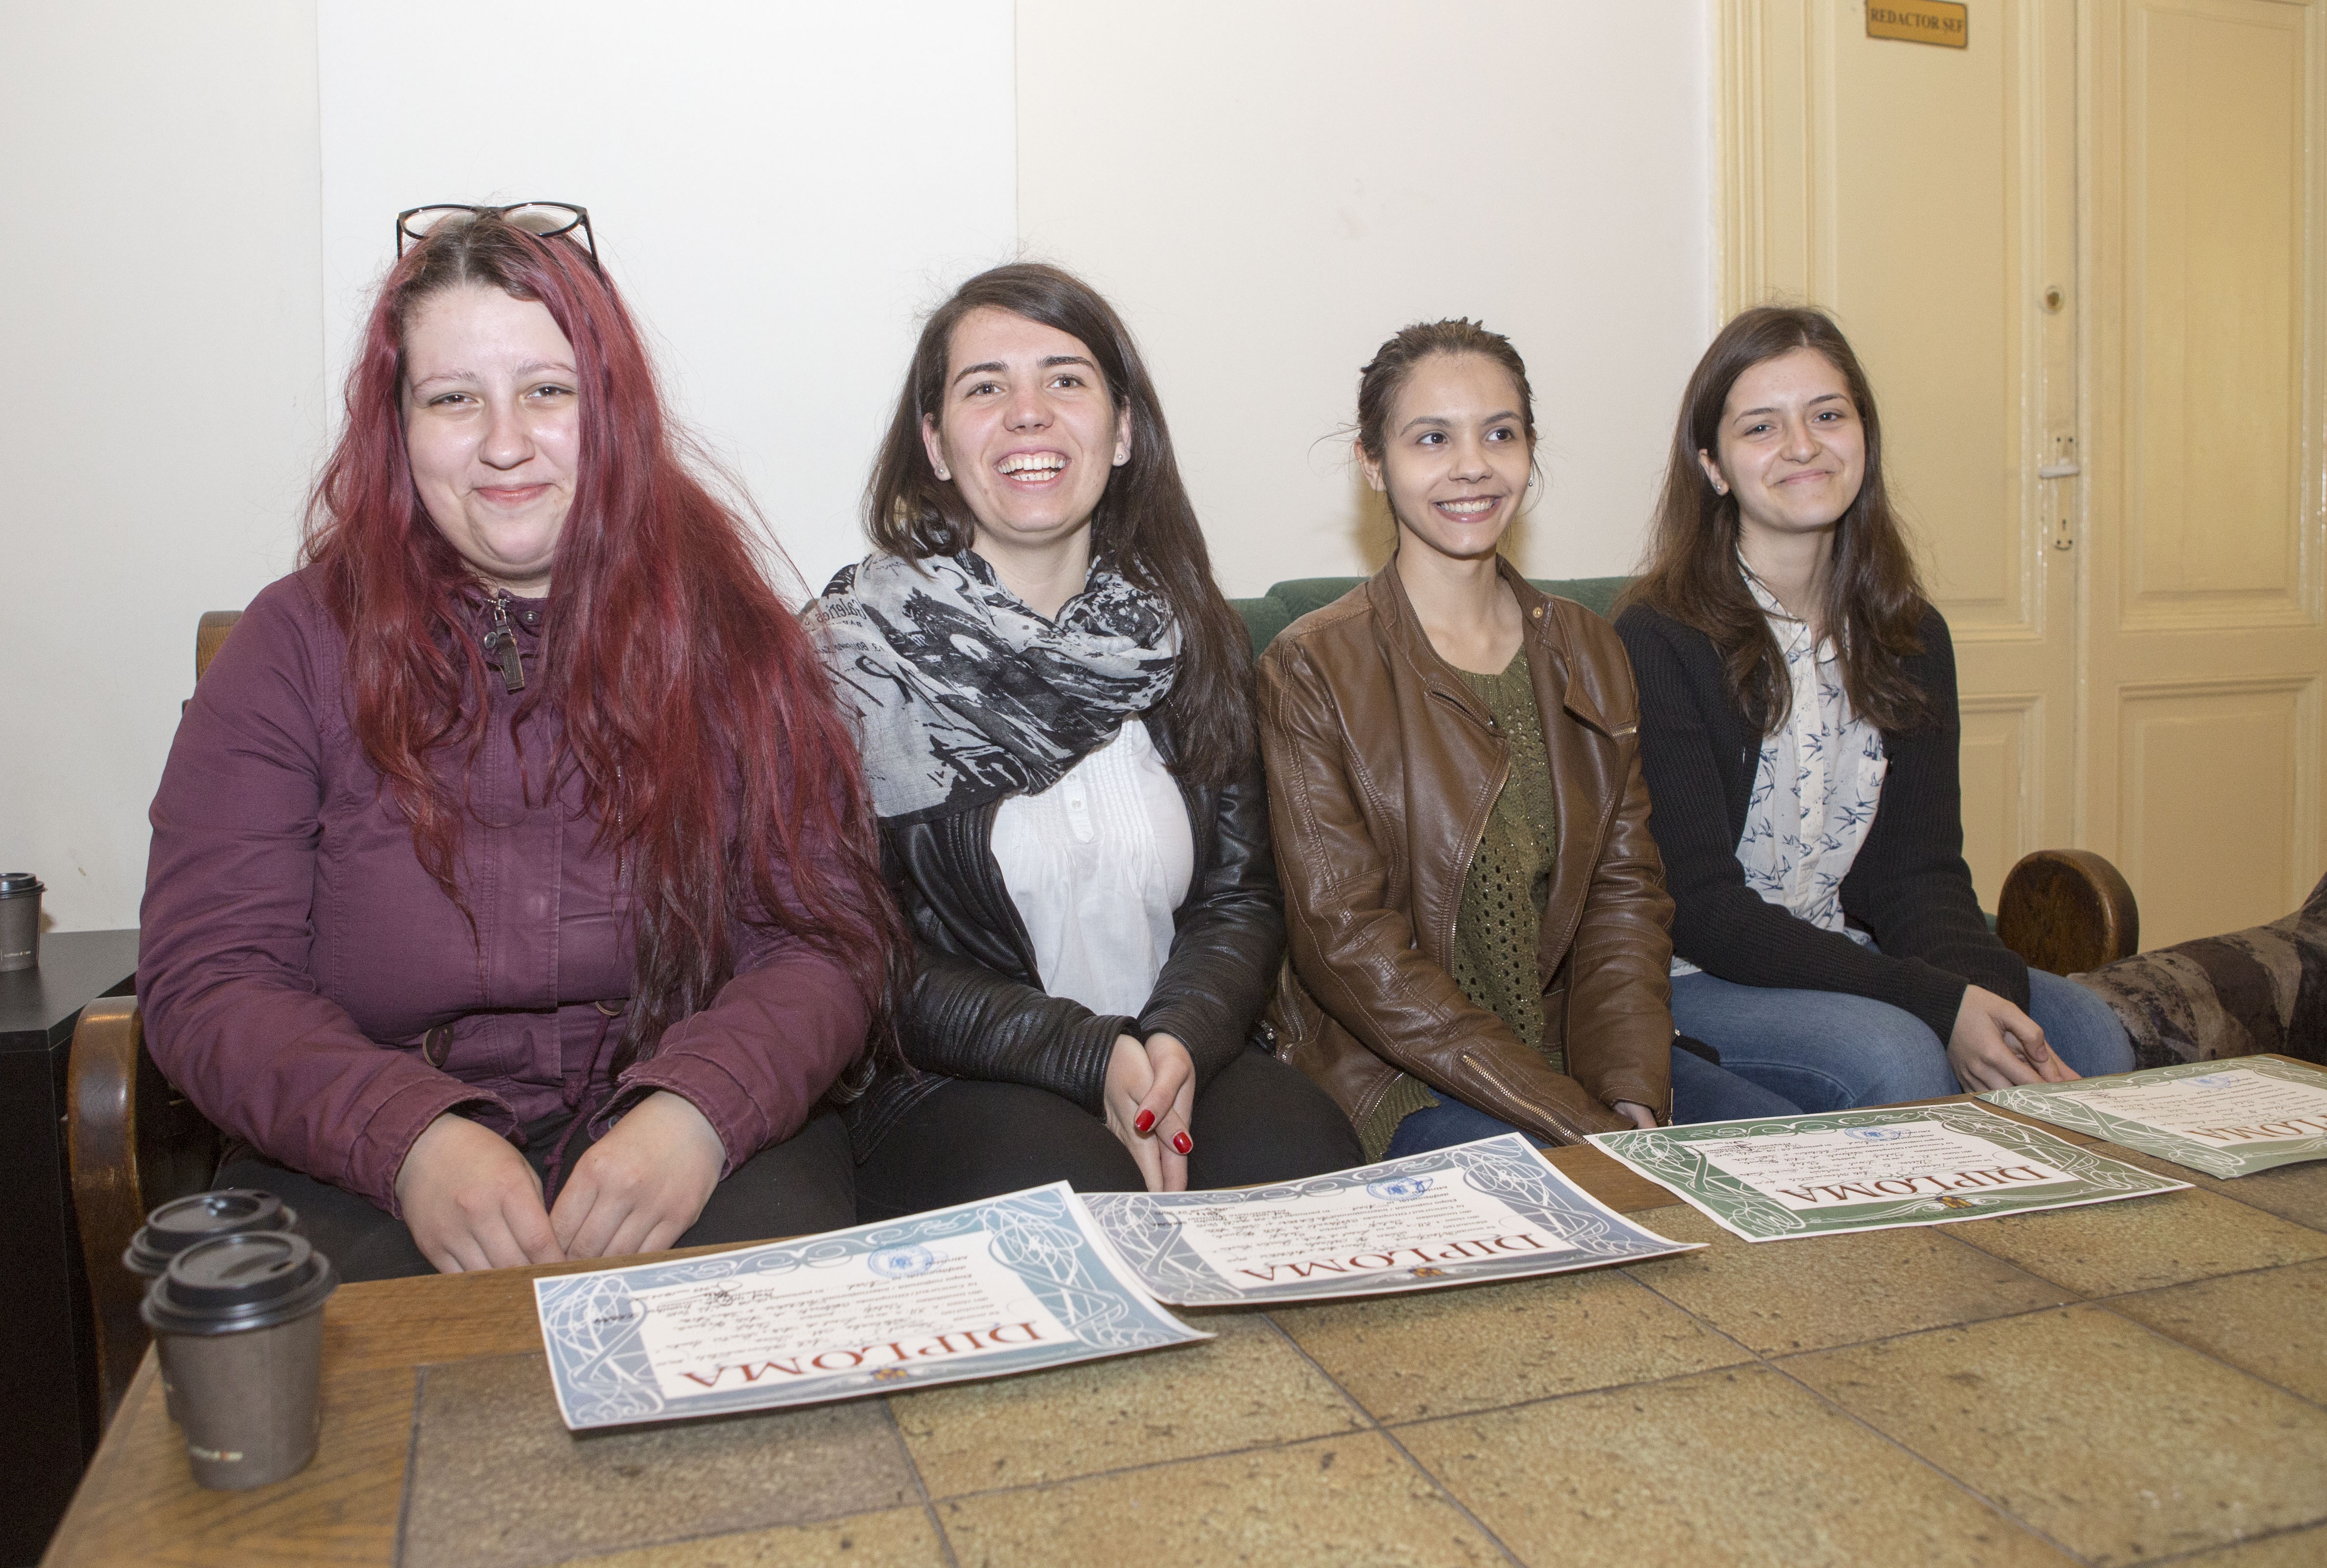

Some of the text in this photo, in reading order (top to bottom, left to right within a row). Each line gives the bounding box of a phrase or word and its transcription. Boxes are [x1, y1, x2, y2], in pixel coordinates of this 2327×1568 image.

[1870, 8, 1939, 30] REDACTOR
[2183, 1115, 2327, 1141] LOMA
[1775, 1165, 2053, 1203] DIPLOMA
[1236, 1233, 1545, 1281] DIPLOMA
[682, 1322, 1046, 1387] DIPLOMA
